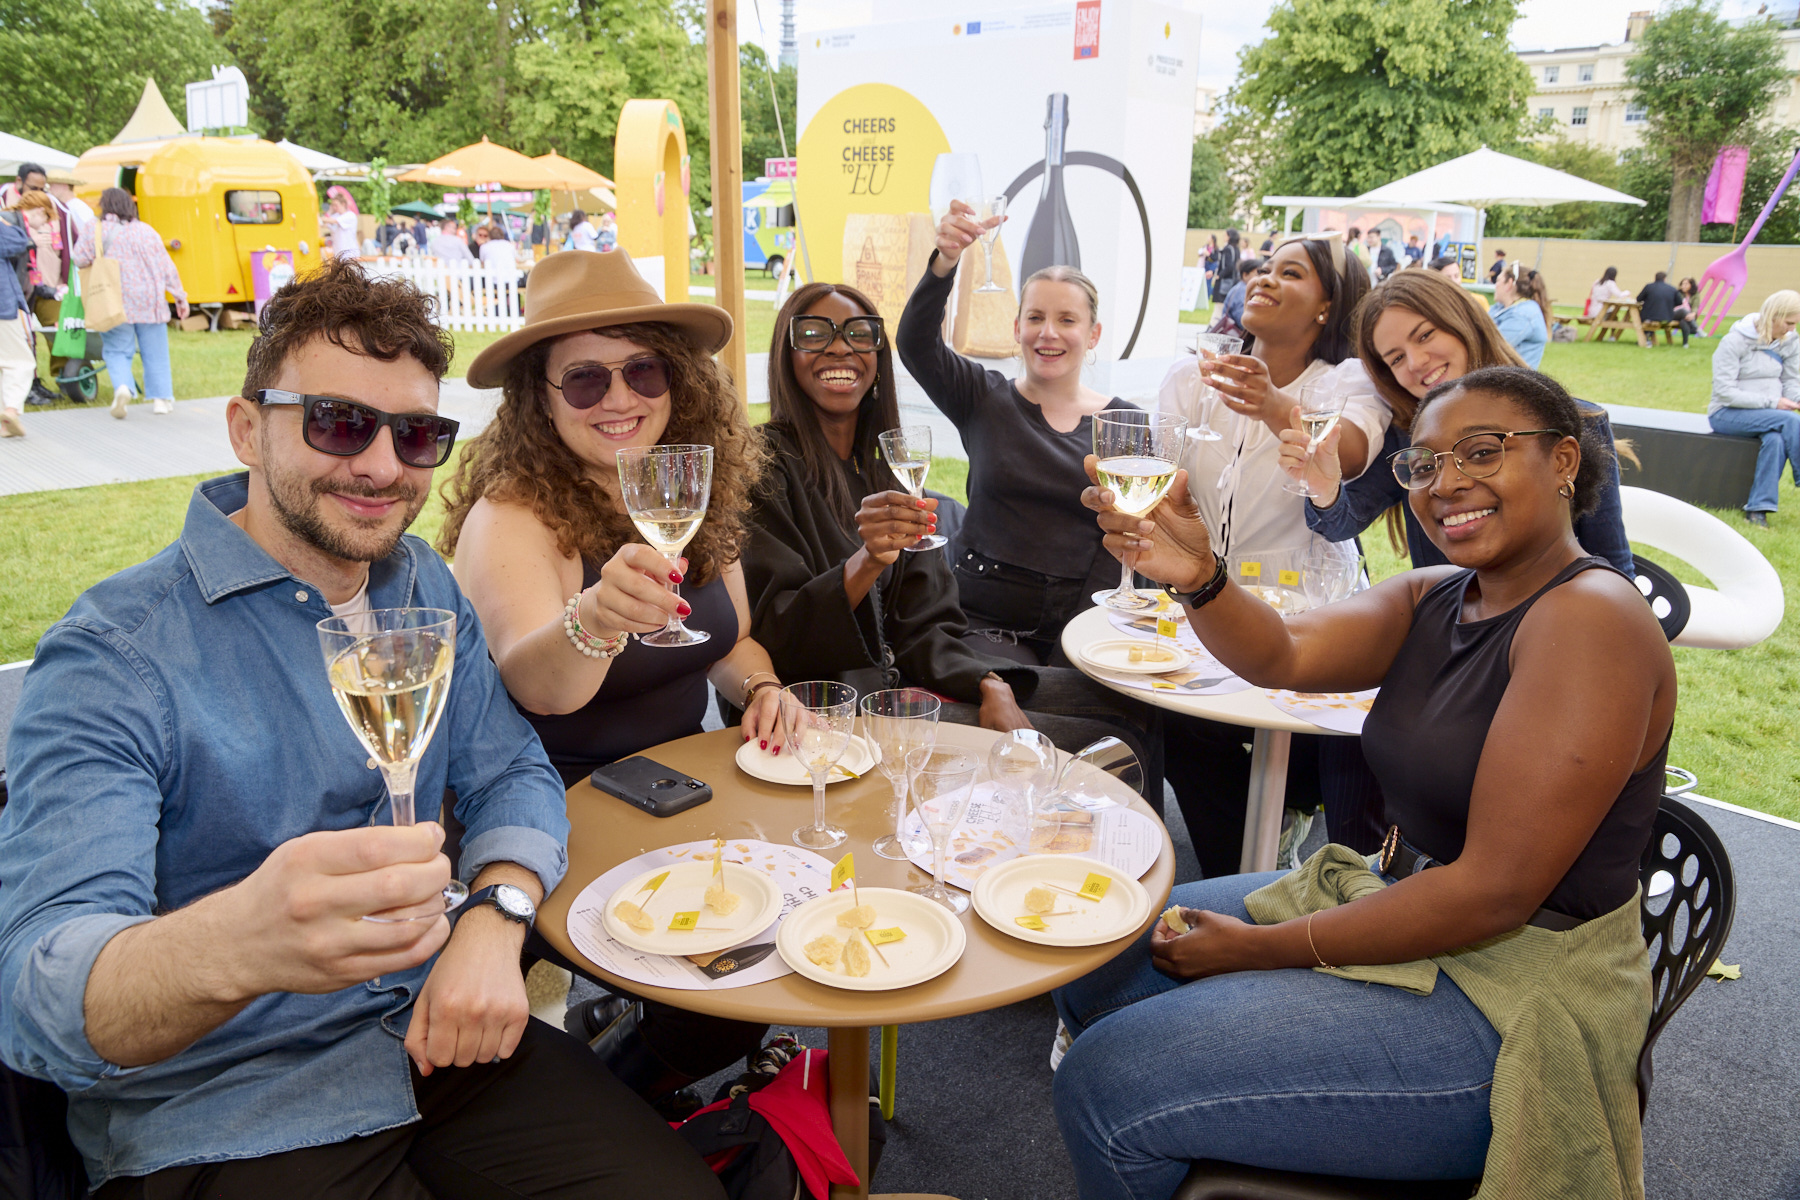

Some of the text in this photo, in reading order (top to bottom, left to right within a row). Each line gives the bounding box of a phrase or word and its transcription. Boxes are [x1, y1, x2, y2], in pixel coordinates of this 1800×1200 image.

[843, 117, 896, 134] CHEERS
[842, 145, 895, 162] CHEESE
[841, 163, 893, 196] TO EU
[965, 802, 982, 824] CHEESE
